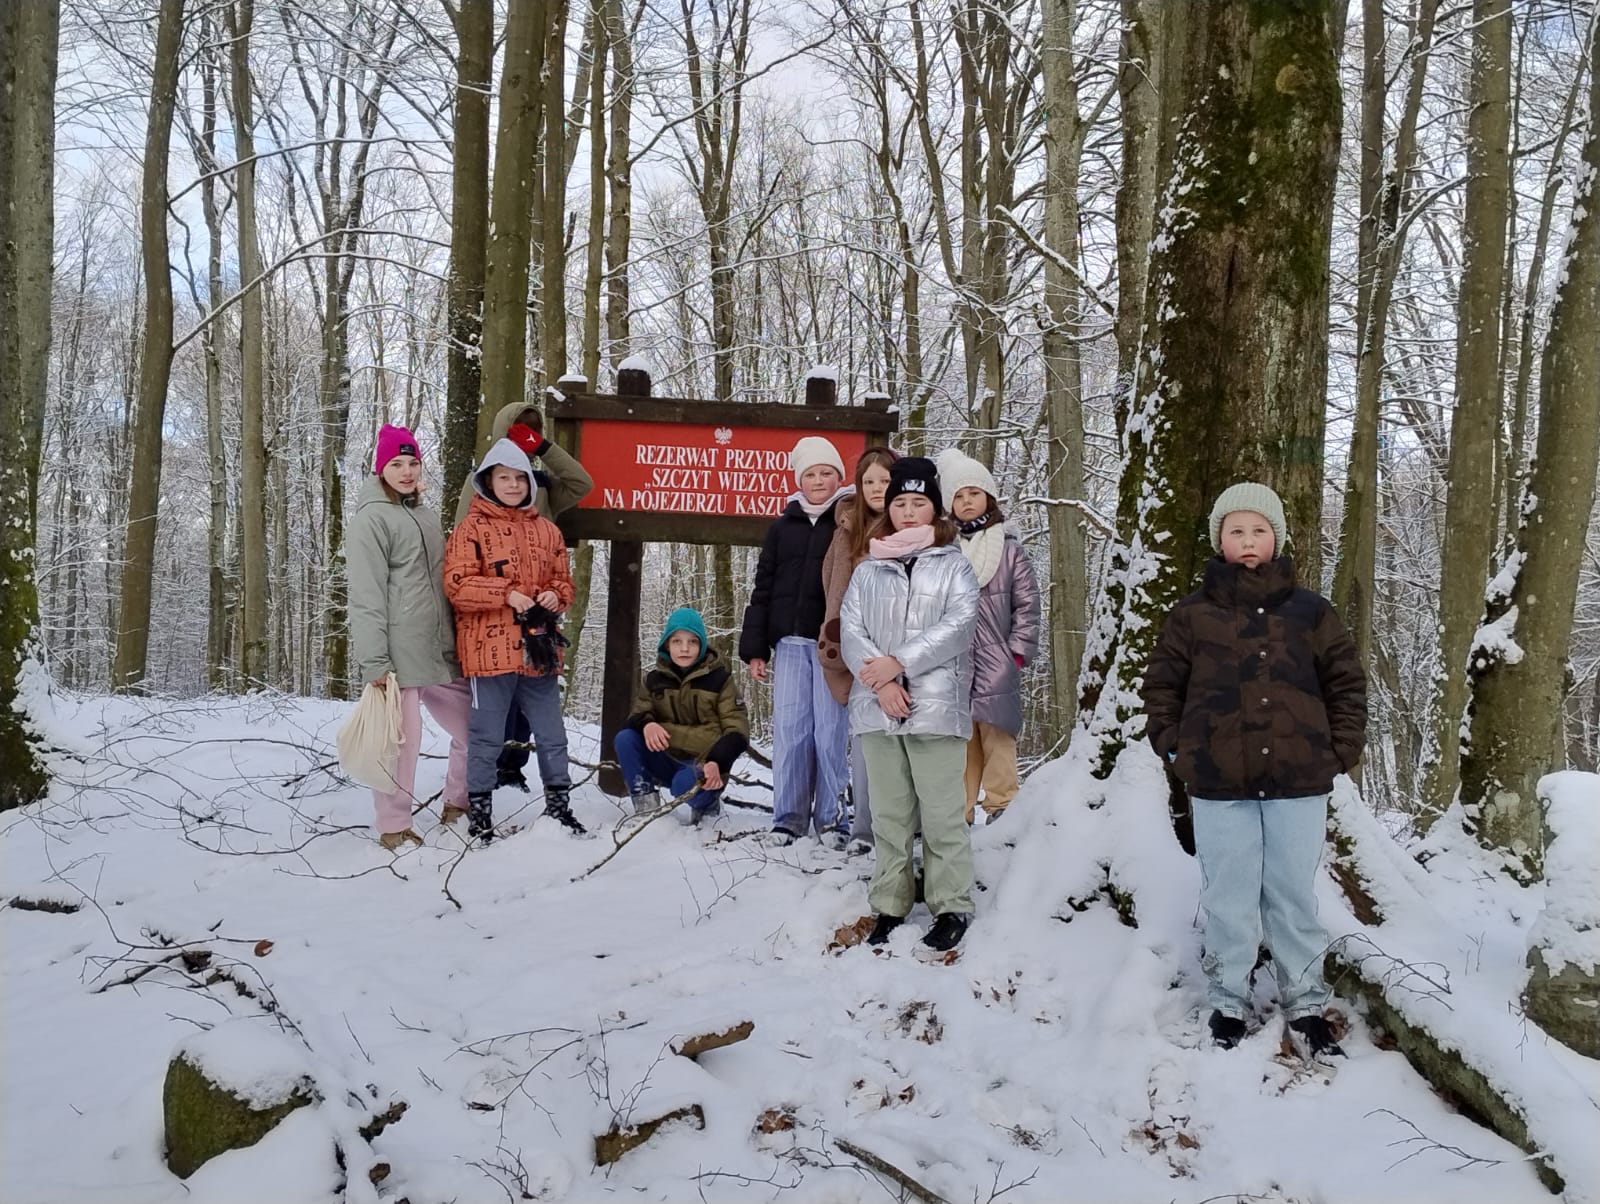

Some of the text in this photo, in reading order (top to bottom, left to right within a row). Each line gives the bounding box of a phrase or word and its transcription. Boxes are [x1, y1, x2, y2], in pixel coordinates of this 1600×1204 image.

[635, 444, 719, 467] REZERWAT
[718, 469, 789, 493] WIEŻYCA
[602, 488, 625, 509] NA
[631, 489, 728, 513] POJEZIERZU
